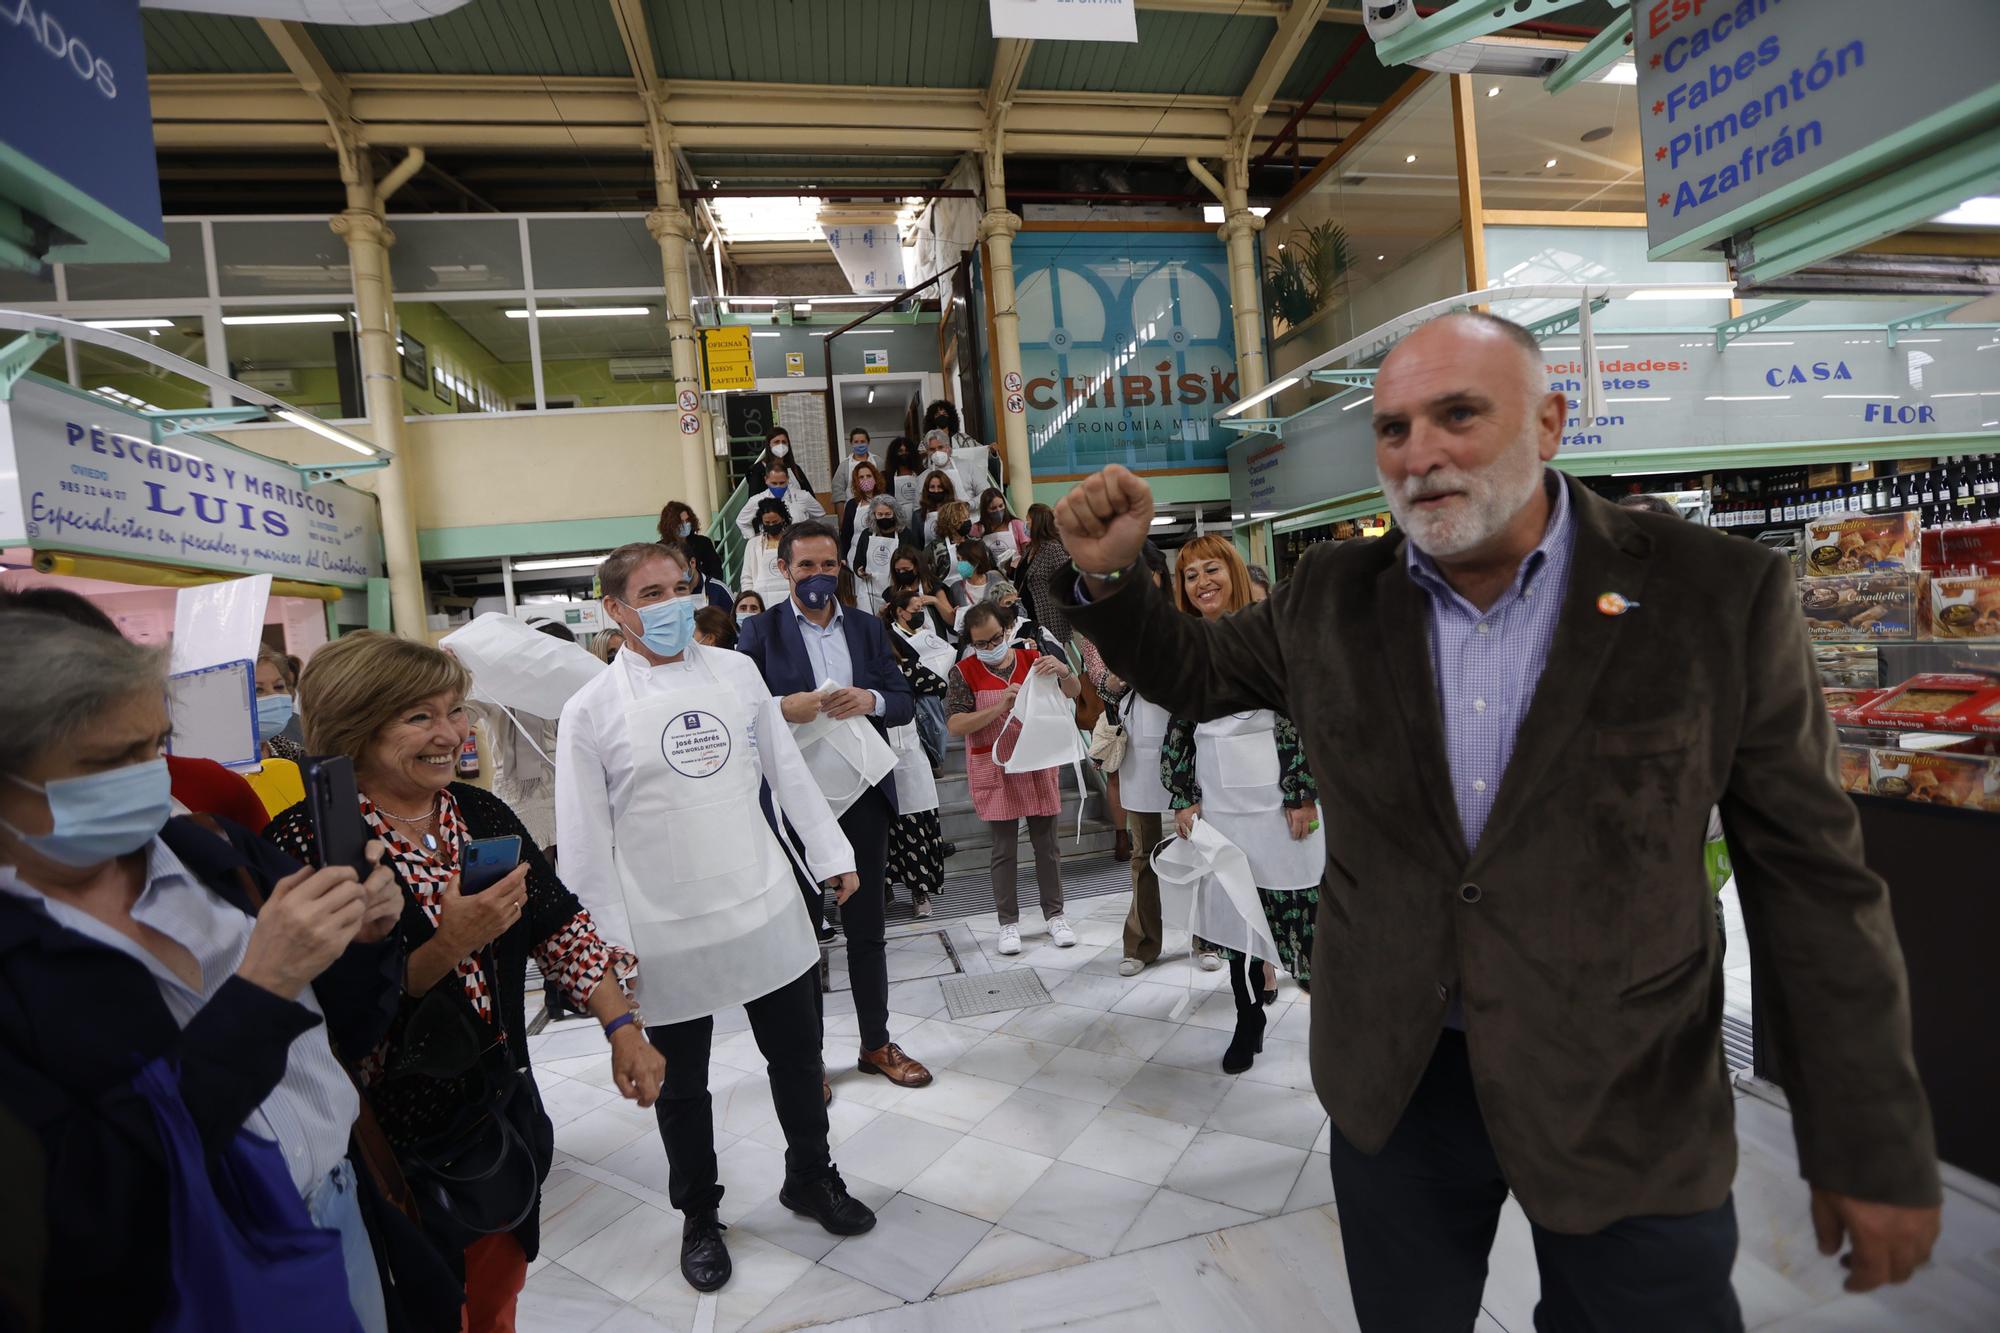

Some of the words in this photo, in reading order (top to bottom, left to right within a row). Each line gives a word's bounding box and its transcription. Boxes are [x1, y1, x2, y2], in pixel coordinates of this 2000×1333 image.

[1667, 35, 1780, 123] Fabes
[1670, 39, 1865, 170] Pimentón
[1673, 120, 1822, 217] Azafrán
[1766, 361, 1853, 387] CASA
[1865, 403, 1936, 424] FLOR
[66, 422, 216, 483] PESCADOS
[223, 468, 236, 489] Y
[245, 474, 336, 519] MARISCOS
[32, 491, 152, 541] Especialistas
[159, 529, 176, 544] en
[143, 481, 289, 537] LUIS
[1847, 592, 1906, 602] Casadielles
